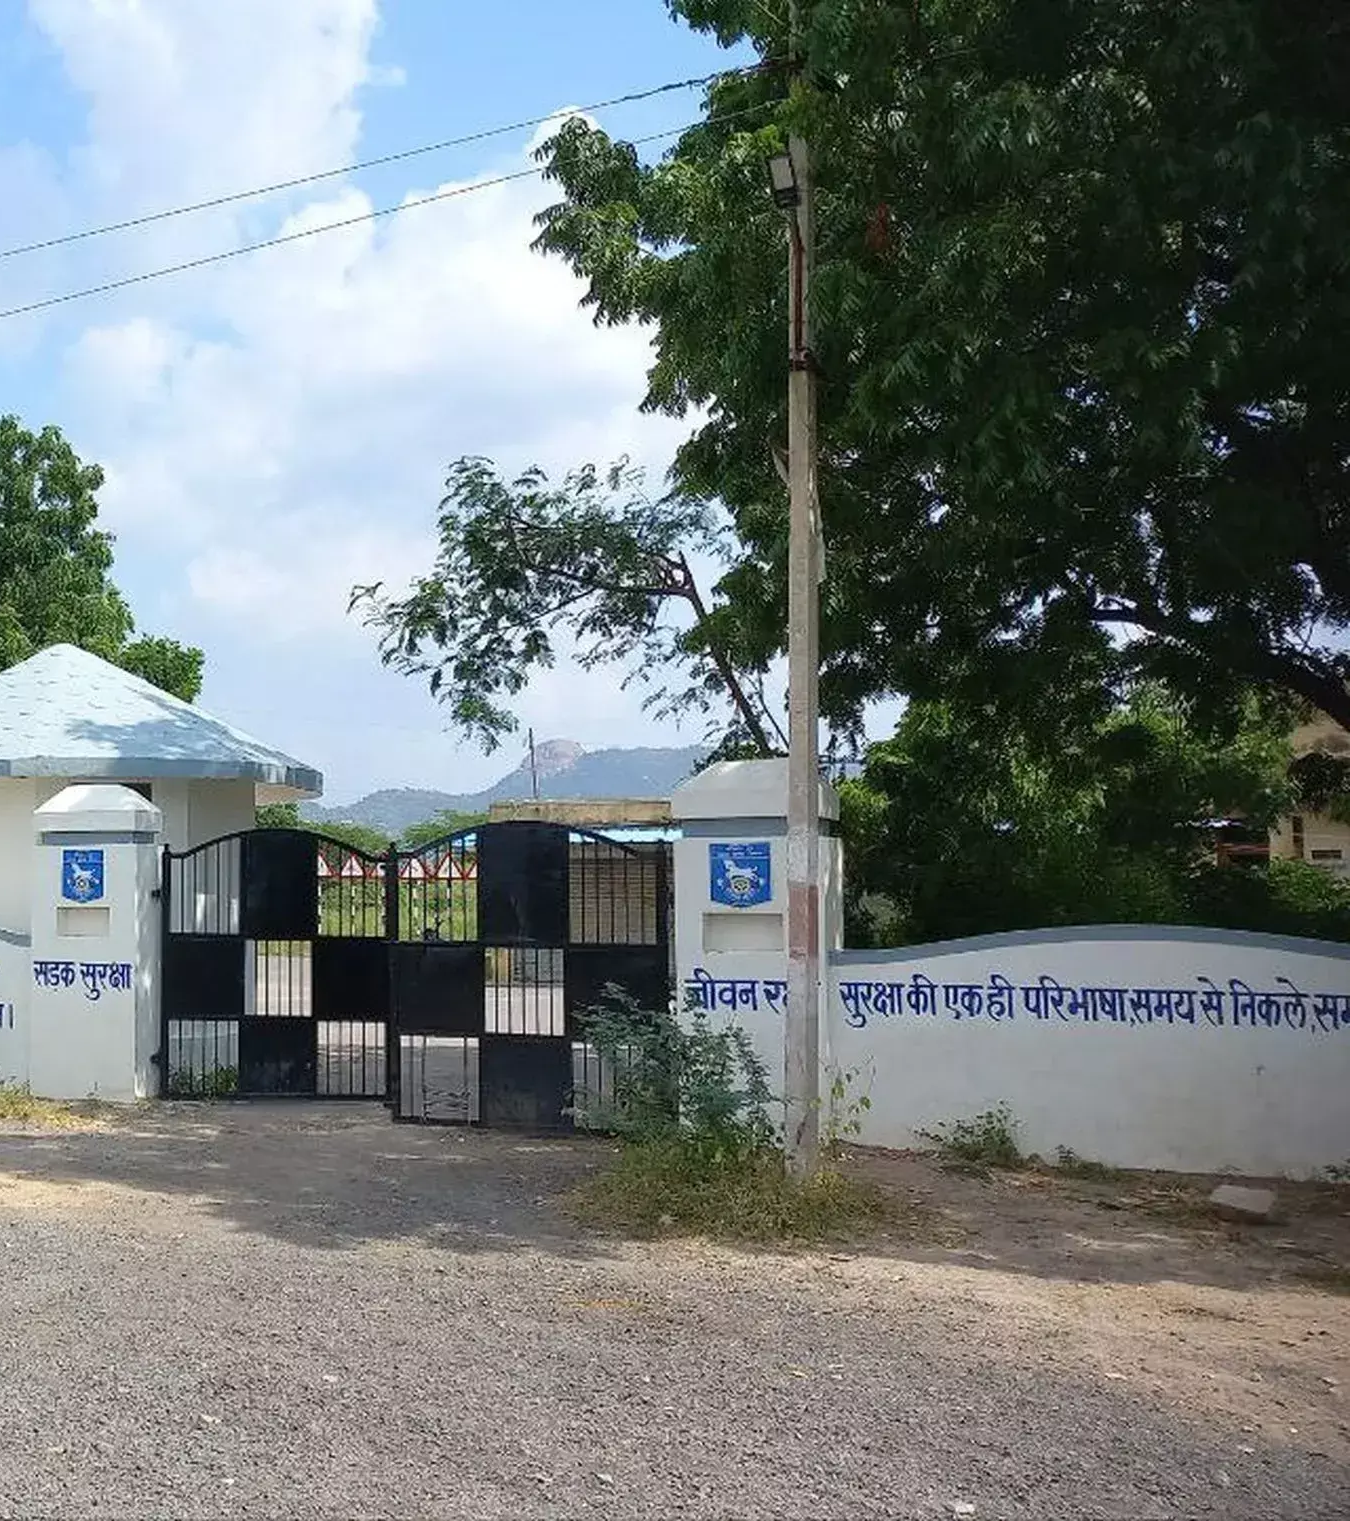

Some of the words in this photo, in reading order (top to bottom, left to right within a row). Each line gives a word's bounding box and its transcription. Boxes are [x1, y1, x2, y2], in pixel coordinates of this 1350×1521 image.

[80, 962, 133, 1001] सुरक्षा
[684, 967, 759, 1012] जीवन
[839, 980, 905, 1029] सुरक्षा
[906, 973, 939, 1018] की
[942, 984, 984, 1020] एक
[986, 973, 1016, 1022] ही
[1197, 976, 1226, 1027] से
